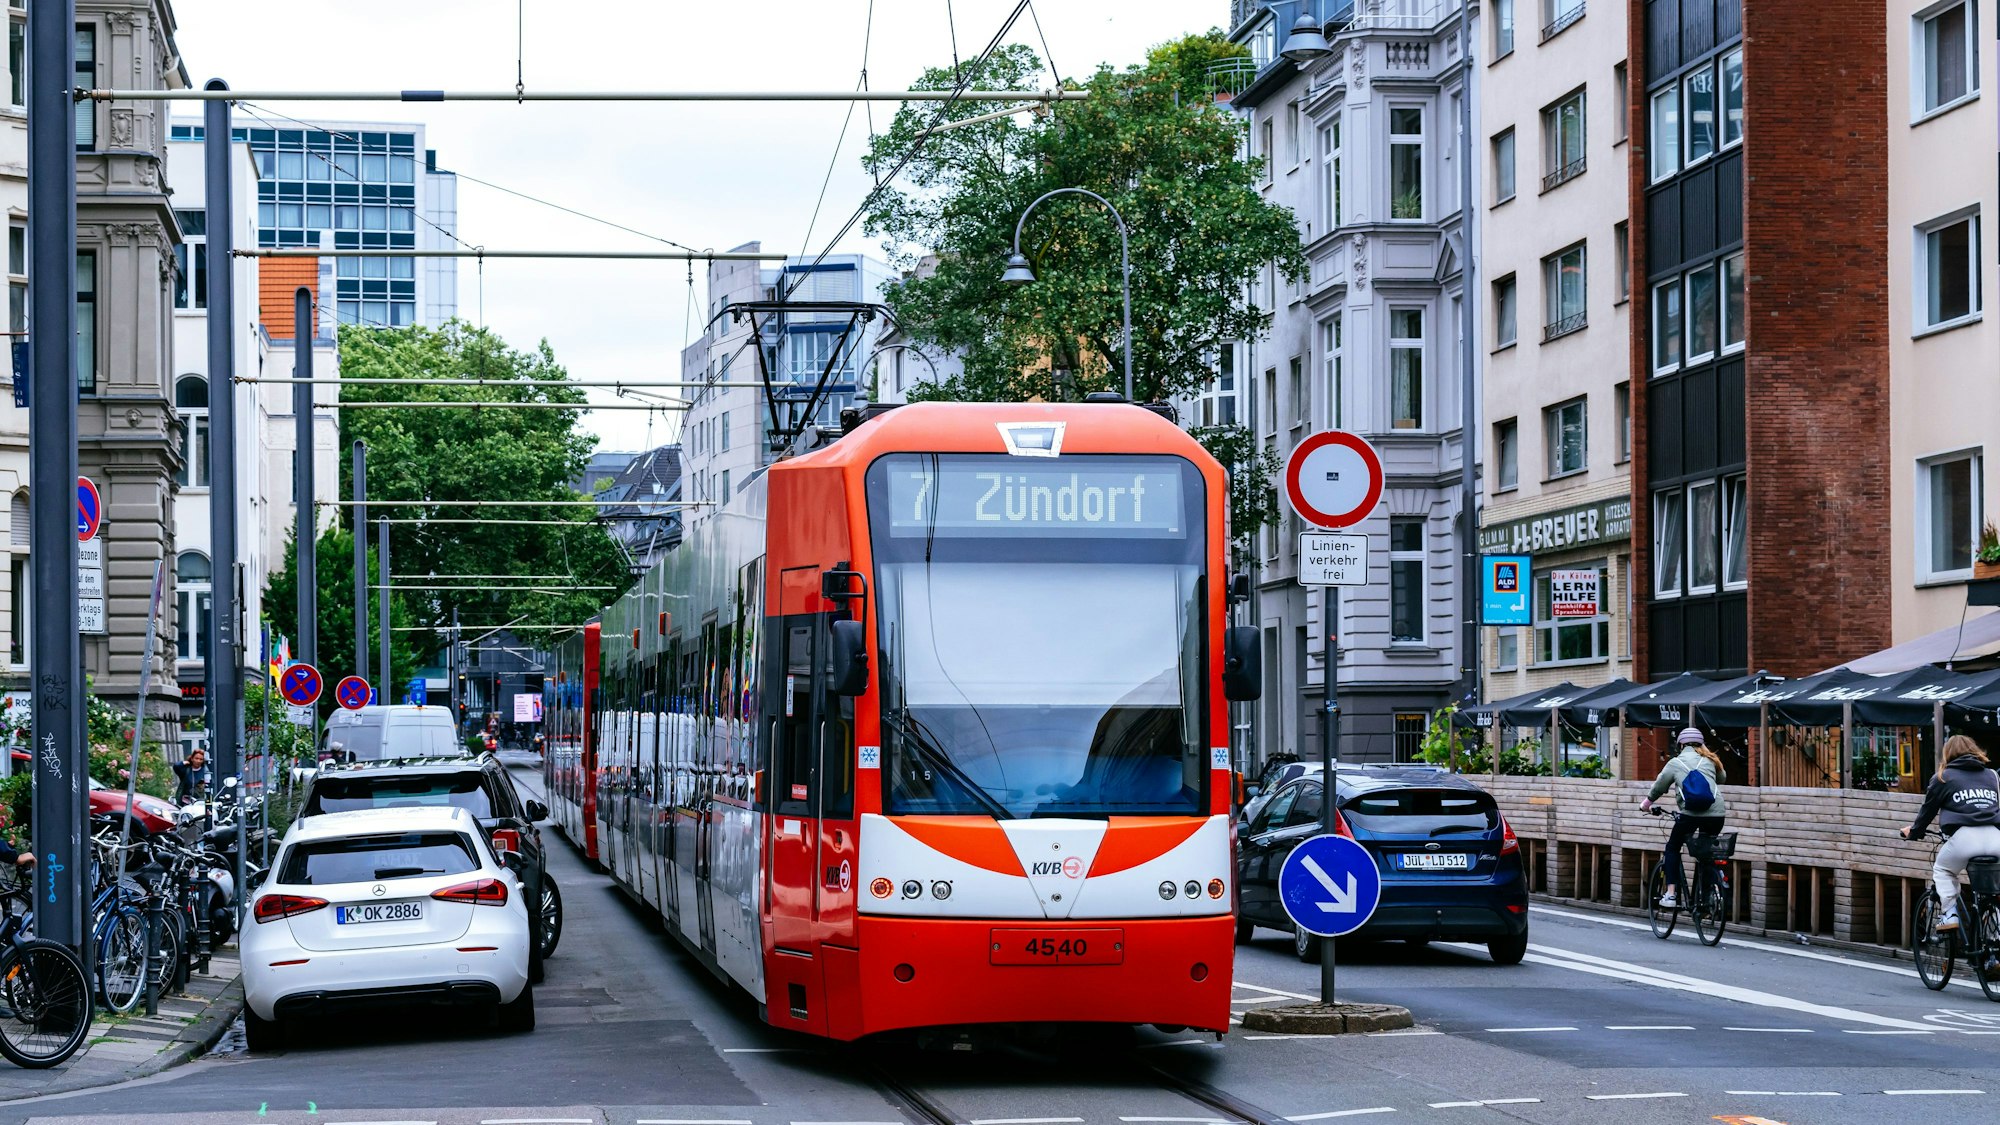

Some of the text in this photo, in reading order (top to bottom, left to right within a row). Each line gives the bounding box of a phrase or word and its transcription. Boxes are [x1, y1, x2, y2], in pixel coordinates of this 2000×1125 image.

[911, 473, 1145, 522] 7 Zündorf
[1532, 508, 1600, 551] BREUER
[1479, 528, 1509, 546] GUMMI
[1312, 539, 1355, 551] Linien-
[1309, 554, 1358, 566] verkehr
[85, 573, 95, 584] dem
[1323, 568, 1344, 580] frei
[1552, 571, 1596, 580] Die Kölner
[1553, 582, 1596, 591] LERN
[1553, 592, 1596, 601] HILFE
[924, 770, 931, 781] 5
[1405, 855, 1466, 866] JÜL LD 512
[1032, 861, 1062, 875] KVB
[827, 866, 840, 885] KVB
[346, 908, 355, 922] K
[364, 906, 382, 920] OK
[385, 904, 420, 919] 2886
[1025, 938, 1087, 956] 4540
